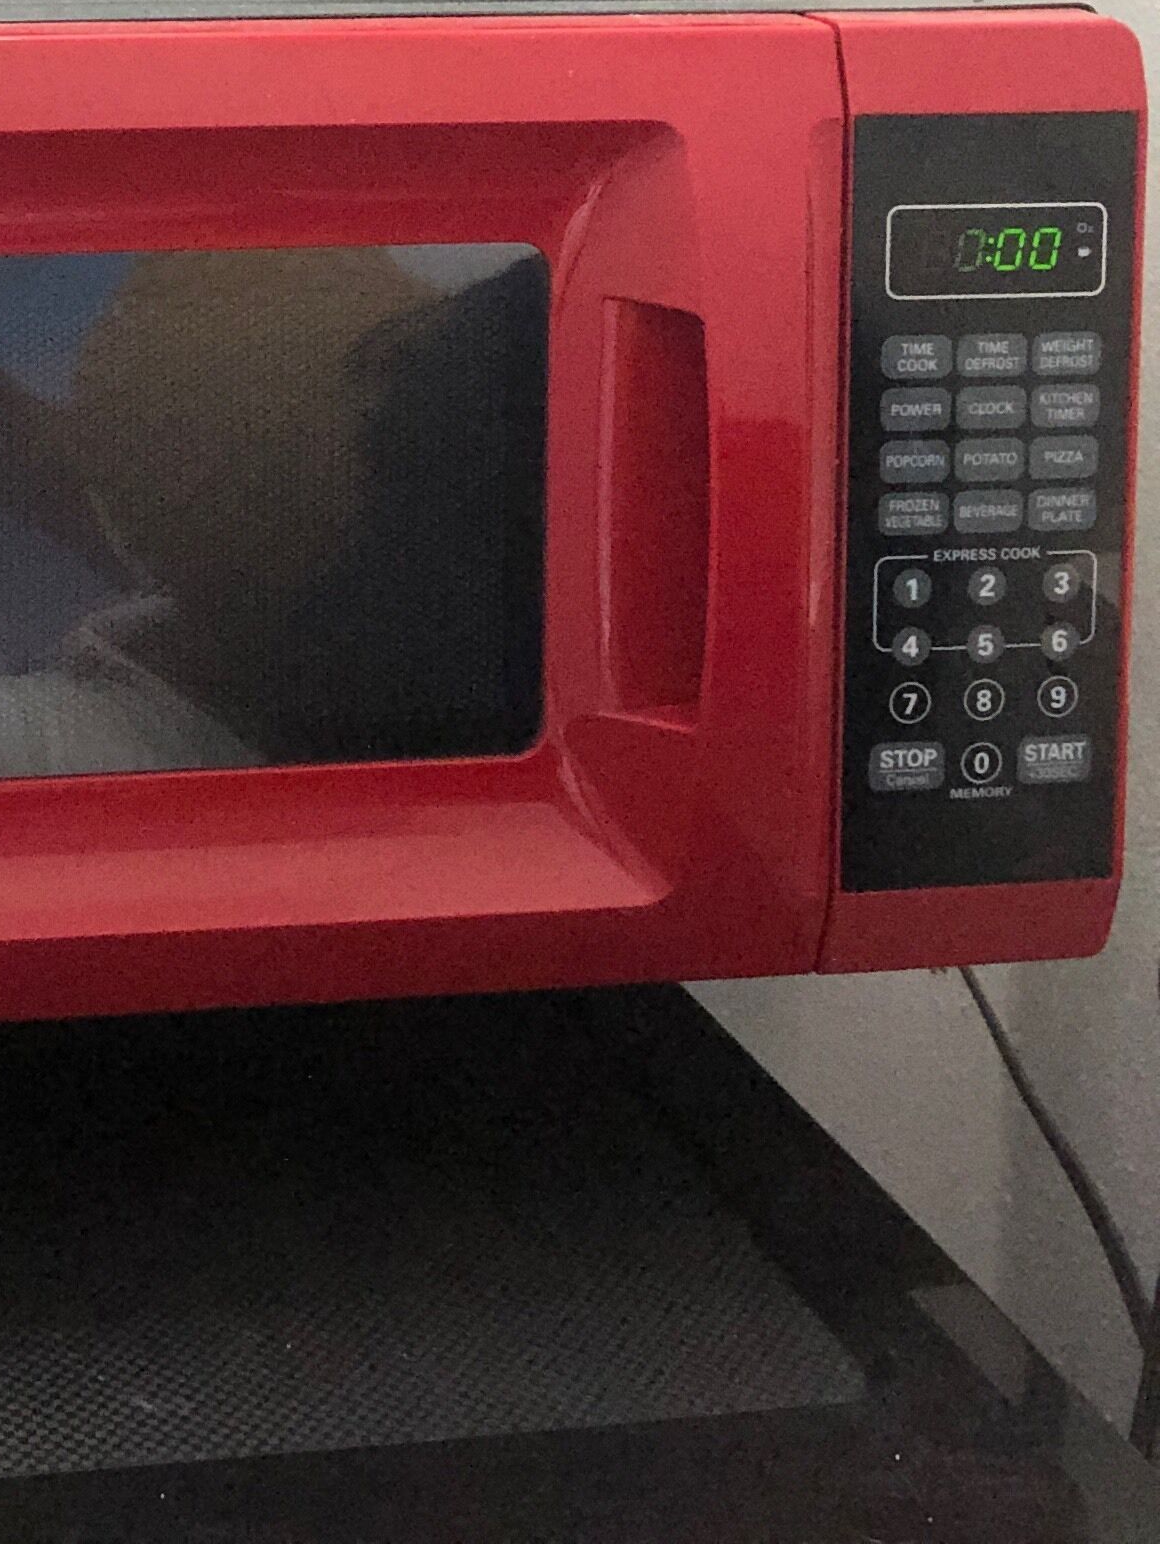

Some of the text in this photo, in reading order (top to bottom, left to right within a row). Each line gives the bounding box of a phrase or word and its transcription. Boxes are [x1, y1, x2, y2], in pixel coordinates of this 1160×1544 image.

[901, 343, 934, 355] TIME
[978, 341, 1009, 354] TIME
[1041, 339, 1093, 352] WEIGHT
[897, 359, 938, 372] COOK
[965, 357, 1019, 370] DEFROST
[1040, 355, 1093, 368] DEFROST
[1039, 392, 1093, 404] KITCHEN
[891, 404, 941, 417] POWER
[969, 401, 1015, 415] CLOCK
[1047, 408, 1084, 420] TIMER
[886, 455, 944, 468] POPCORN
[963, 452, 1018, 465] POTATO
[1044, 450, 1083, 463] PIZZA
[890, 499, 939, 512] FROZEN
[1036, 495, 1089, 507] DINNER
[960, 505, 1018, 518] BEVERAGE
[1042, 510, 1082, 523] PLATE
[934, 545, 1041, 562] EXPRESS COOK
[906, 578, 917, 601] 1
[979, 574, 996, 597] 2
[1054, 572, 1070, 594] 3
[902, 635, 919, 657] 4
[977, 633, 994, 656] 5
[1051, 630, 1068, 652] 6
[976, 689, 992, 712] 8
[1050, 686, 1066, 708] 9
[902, 693, 918, 715] 7
[1024, 741, 1086, 762] START
[880, 748, 938, 769] STOP
[973, 752, 990, 774] 0
[950, 786, 1013, 799] MEMORY
